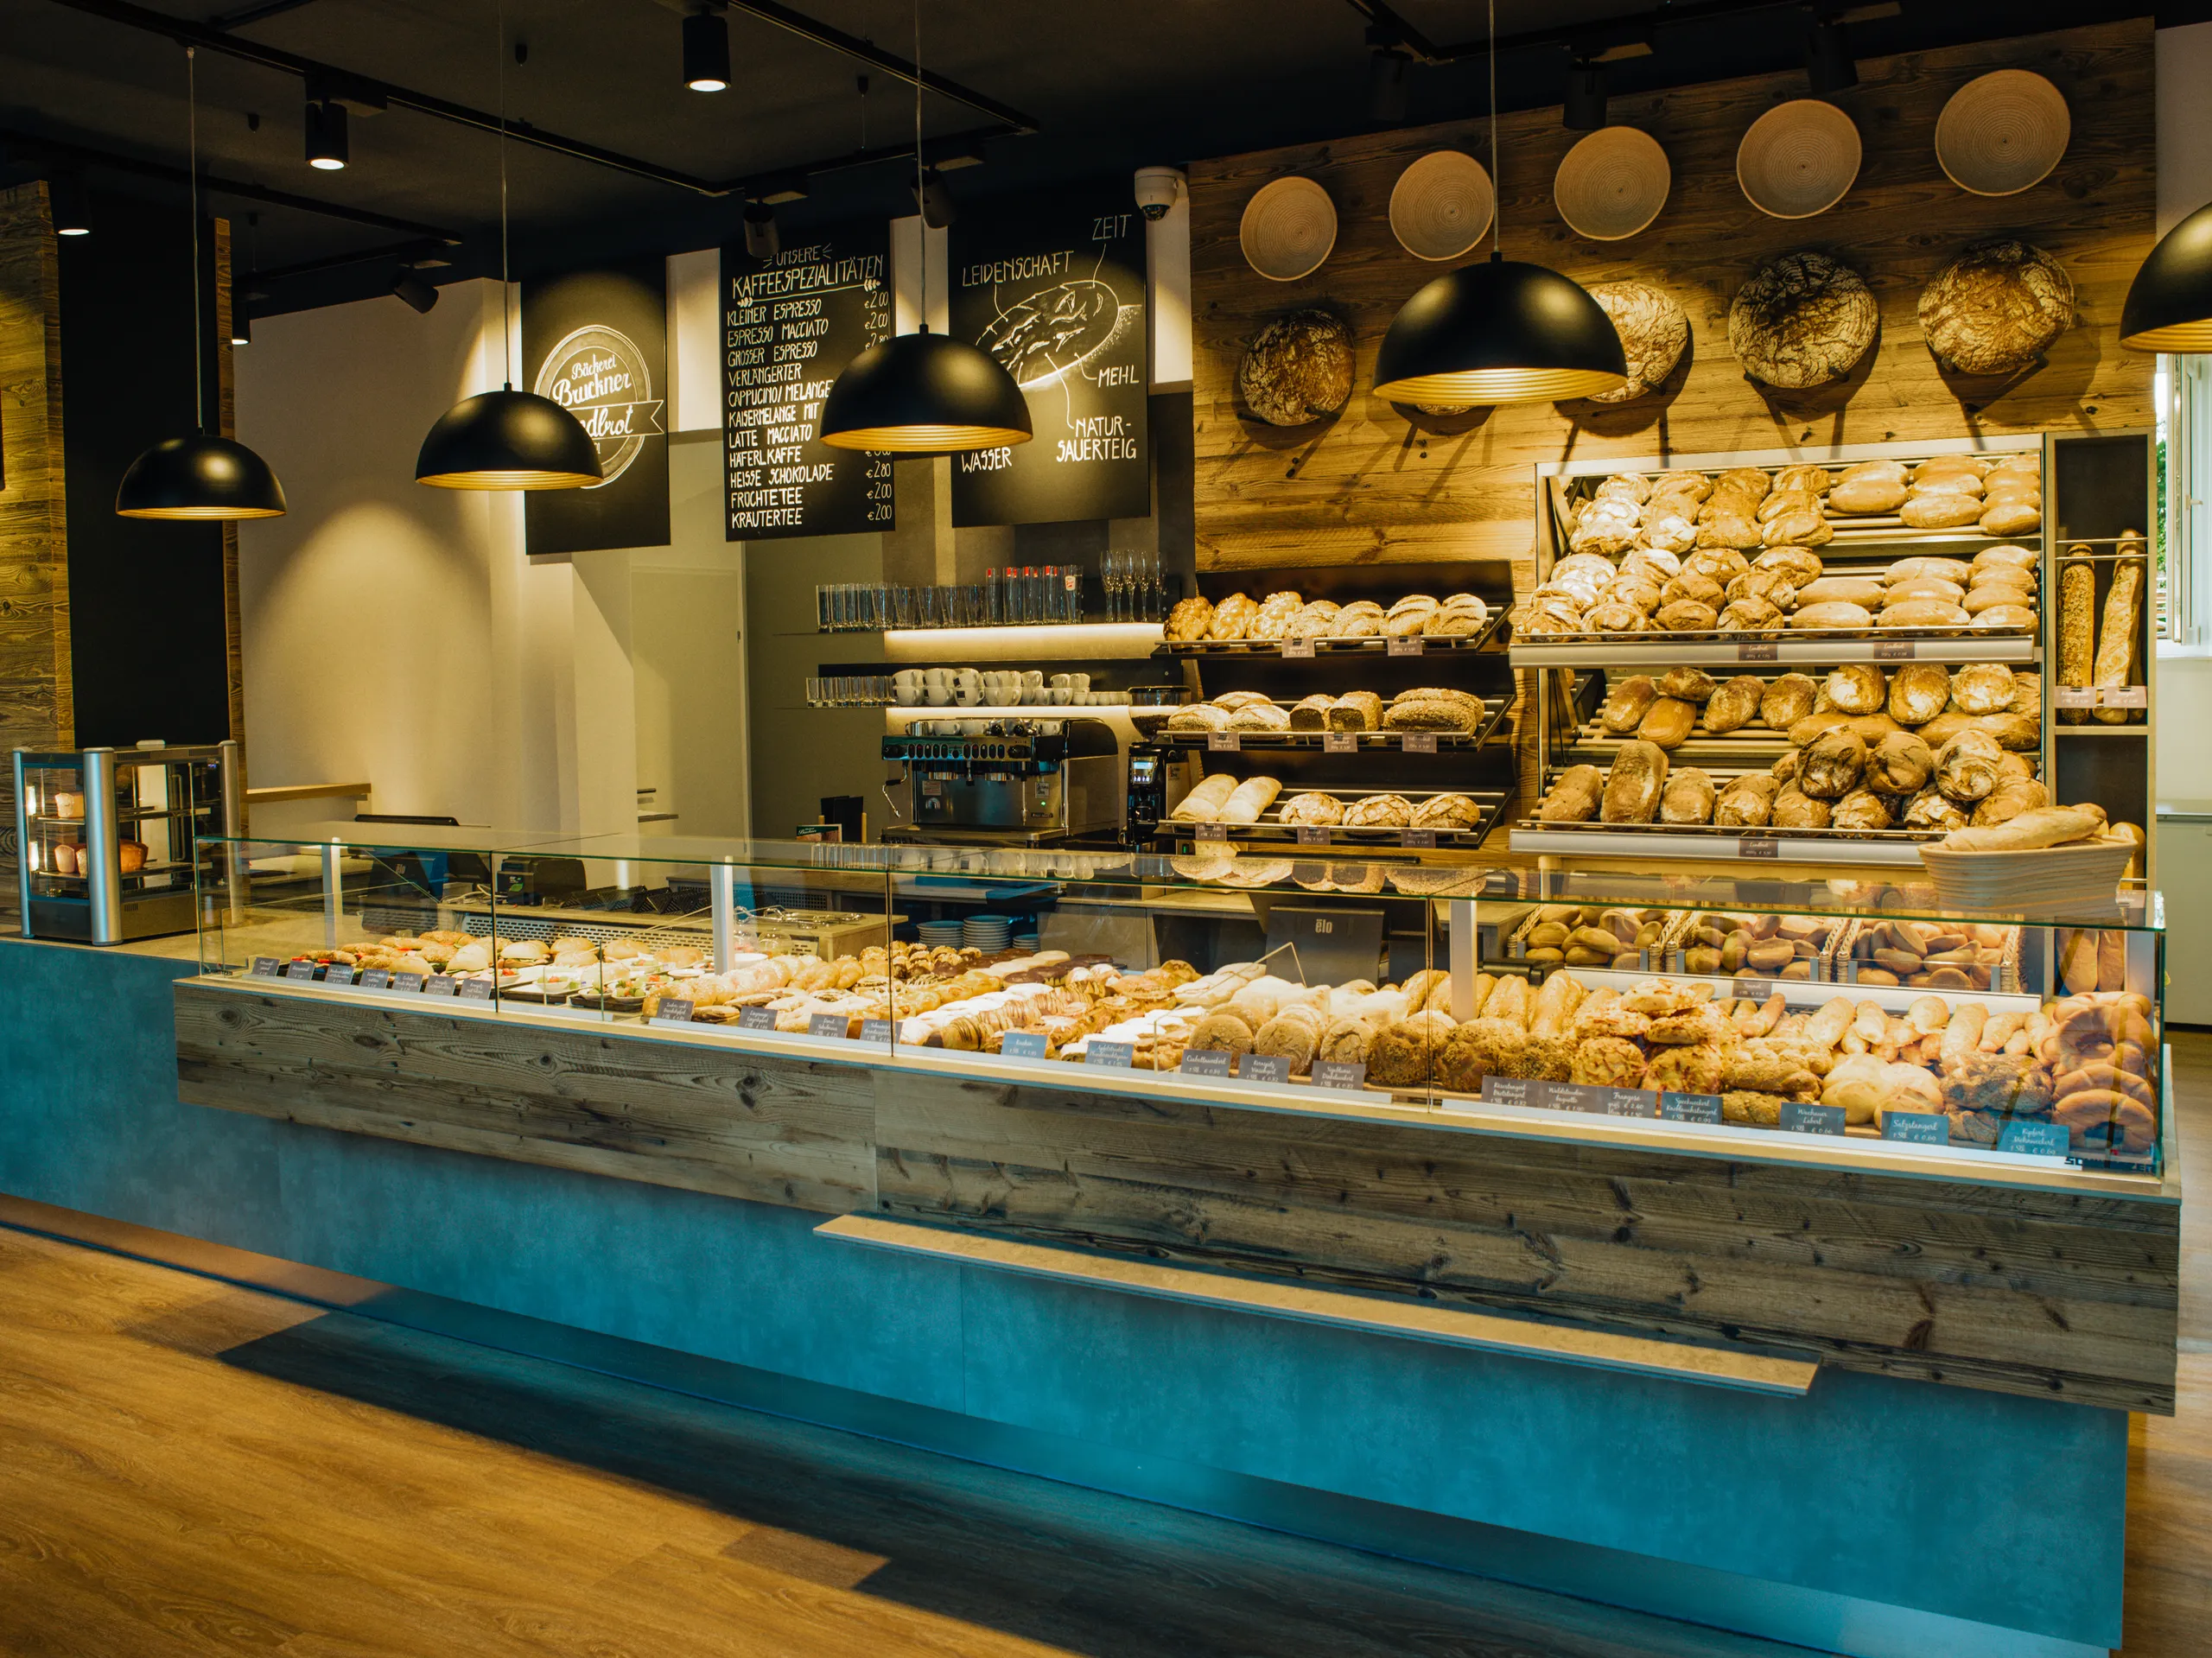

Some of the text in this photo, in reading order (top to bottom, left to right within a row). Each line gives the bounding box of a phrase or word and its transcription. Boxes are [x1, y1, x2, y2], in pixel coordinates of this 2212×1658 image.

[1092, 214, 1132, 240] ZEIT
[776, 245, 821, 266] UNSERE
[733, 254, 883, 299] KAFFEESPEZIALITÄTEN
[962, 251, 1074, 287] LEIDENSCHAFT
[728, 306, 766, 327] KLEINER
[773, 298, 822, 321] ESPRESSO
[728, 326, 773, 348] ESPRESSO
[782, 318, 829, 340] MACCIATO
[571, 353, 617, 380] Bäckerei
[728, 347, 765, 367] GROSSER
[773, 341, 817, 362] ESPRESSO
[728, 363, 802, 387] VERLÄNGERTER
[1098, 365, 1140, 388] MEHL
[552, 371, 632, 407] Bruckner
[785, 380, 834, 403] MELANGE
[728, 403, 820, 429] KAISERMELANGE MIT
[1075, 416, 1132, 438] NATUR-
[729, 424, 813, 449] LATTE MACCIATO
[961, 447, 1013, 473] WASSER
[1056, 438, 1137, 463] SAUERTEIG
[730, 469, 762, 489] HEISSE
[768, 463, 836, 486] SCHOKOLADE
[732, 507, 804, 529] KRÄUTERTEE
